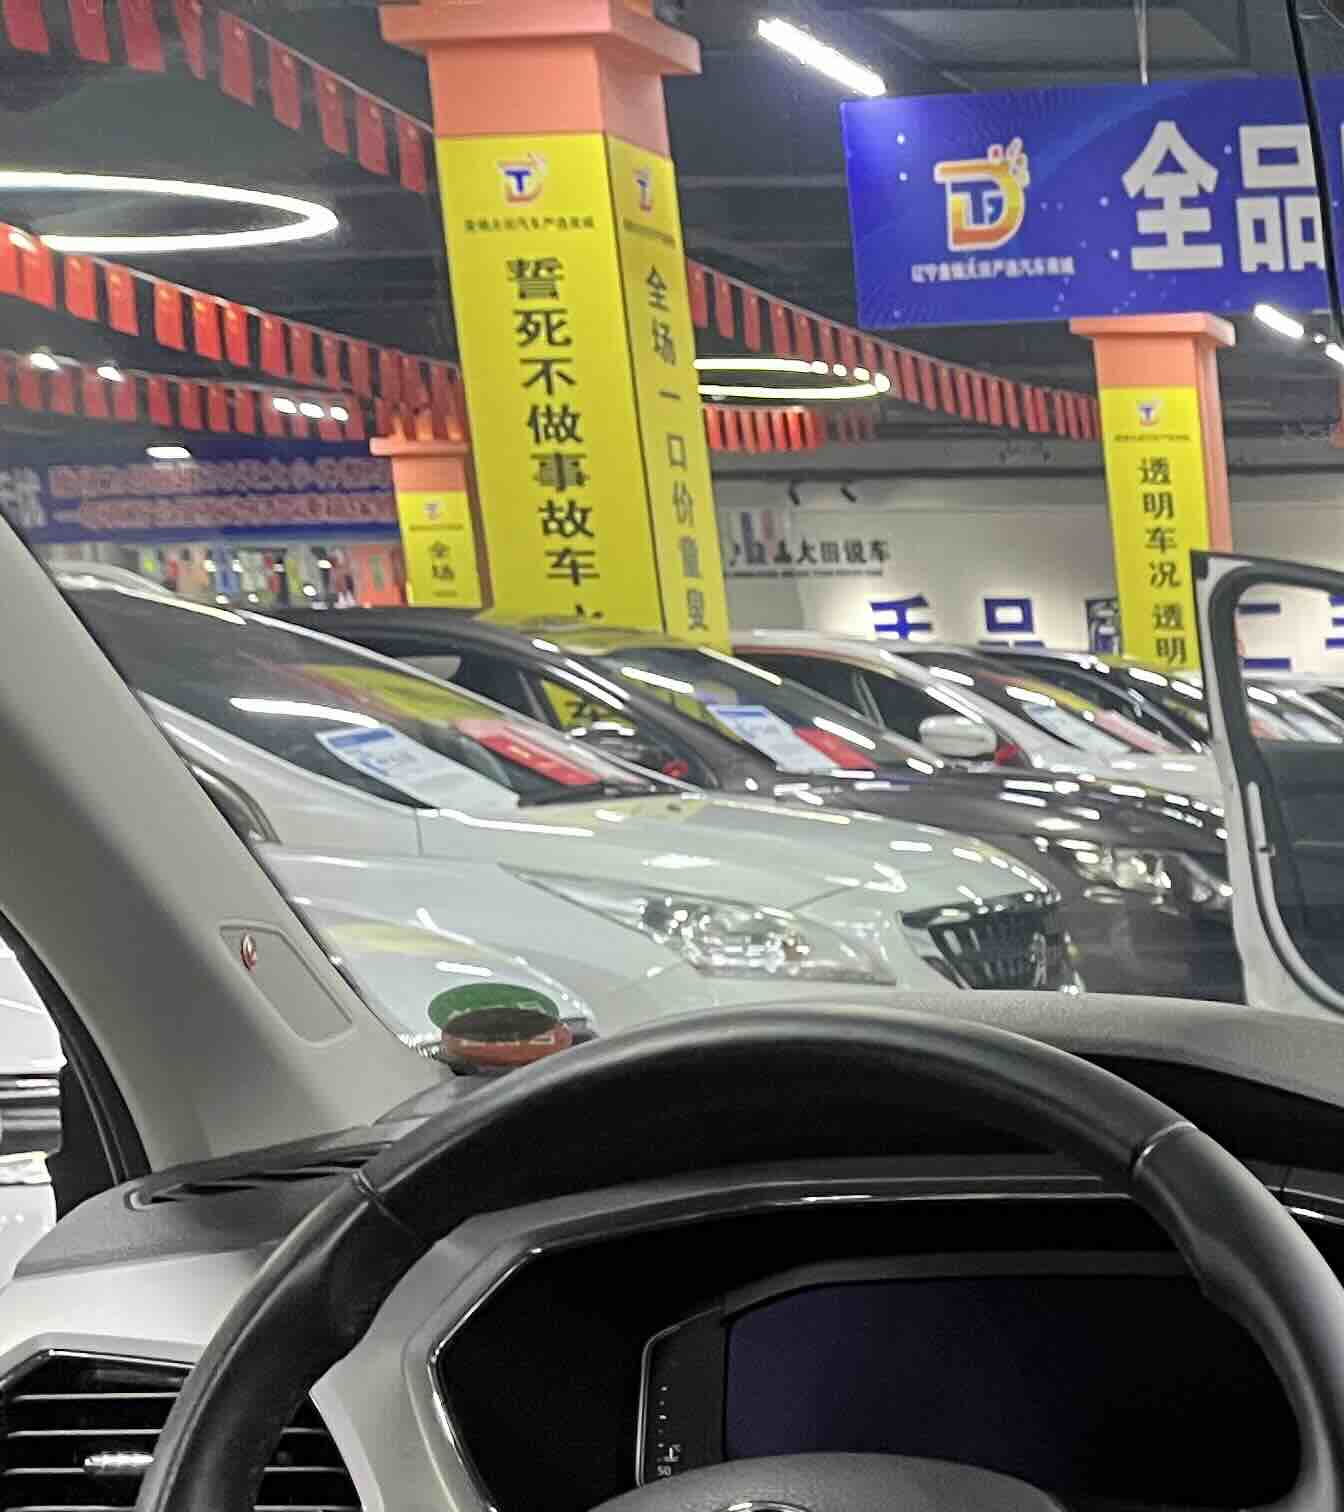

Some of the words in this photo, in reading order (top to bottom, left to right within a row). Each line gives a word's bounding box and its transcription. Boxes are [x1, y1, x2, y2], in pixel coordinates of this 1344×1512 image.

[505, 256, 604, 619] 誓死不做事故车
